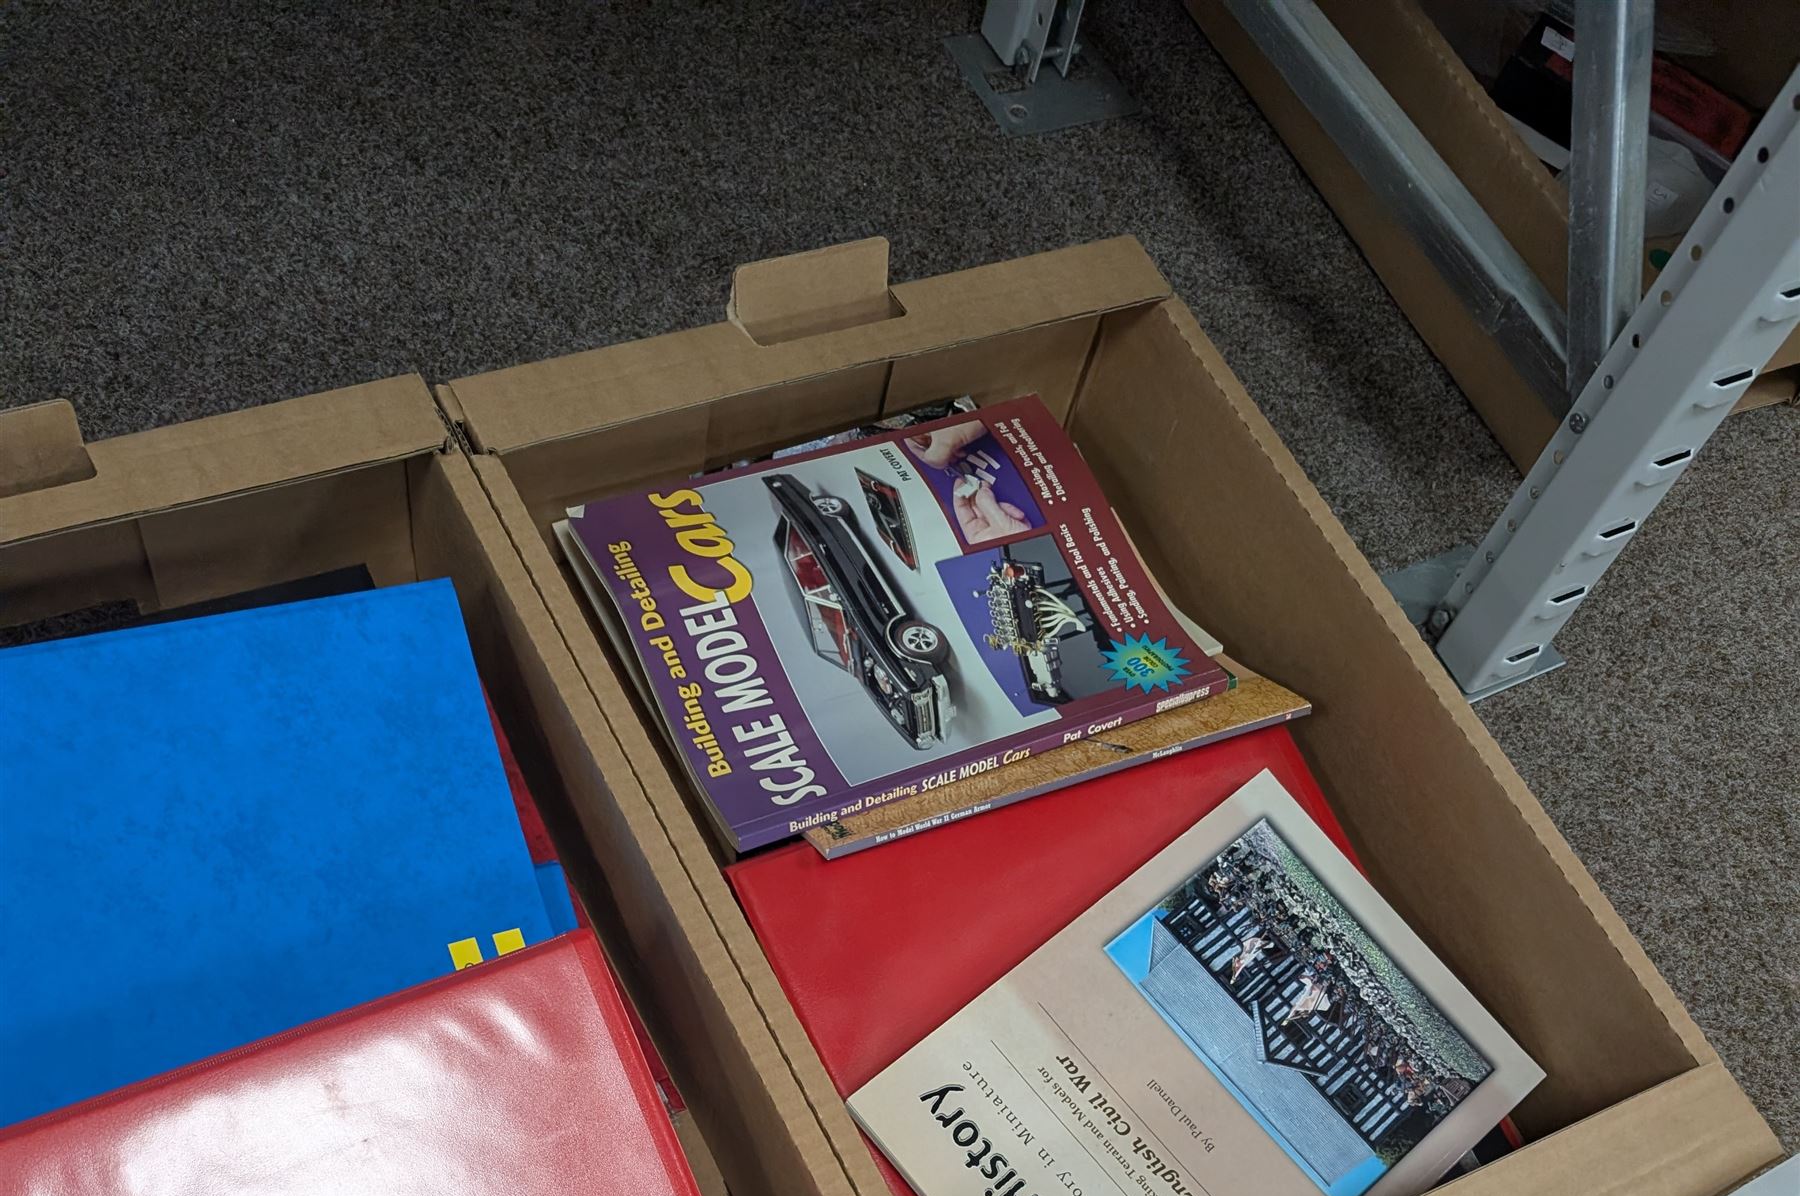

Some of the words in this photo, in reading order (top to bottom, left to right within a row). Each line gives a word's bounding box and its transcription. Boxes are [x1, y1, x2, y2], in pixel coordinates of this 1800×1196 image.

[1010, 417, 1039, 453] Weathering
[1034, 451, 1047, 465] and
[1044, 464, 1065, 496] Detailing
[1059, 523, 1076, 548] Basics
[1081, 507, 1102, 543] Polishing
[648, 489, 753, 604] Cars
[1068, 547, 1083, 565] Tool
[1097, 542, 1111, 557] and
[607, 540, 665, 632] Detailing
[1076, 564, 1092, 581] and
[1096, 566, 1121, 603] Adhesives
[1087, 580, 1121, 628] Fundamentals
[1118, 601, 1134, 624] Using
[649, 635, 687, 680] and
[678, 589, 774, 714] MODEL
[1126, 656, 1155, 678] 300
[678, 682, 733, 778] Building
[731, 713, 827, 806] SCALE
[789, 809, 839, 833] Building
[840, 799, 863, 817] and
[864, 783, 918, 809] Detailing
[921, 769, 957, 792] SCALE
[958, 757, 999, 780] MODEL
[1002, 746, 1032, 766] Cars
[1063, 729, 1082, 743] Pat
[1087, 716, 1123, 736] Covert
[897, 825, 915, 837] Model
[915, 820, 932, 832] World
[931, 817, 943, 828] War
[950, 808, 973, 822] German
[973, 802, 992, 814] Armor
[1037, 1066, 1053, 1084] for
[1055, 1054, 1092, 1095] War
[962, 1060, 1036, 1147] Miniature
[1051, 1082, 1087, 1121] Models
[1088, 1091, 1131, 1137] Civil
[1146, 1078, 1181, 1117] Darnell
[1082, 1120, 1104, 1140] and
[1178, 1113, 1203, 1139] Paul
[1038, 1148, 1055, 1170] in
[1102, 1139, 1138, 1180] Terrain
[1201, 1137, 1215, 1153] By
